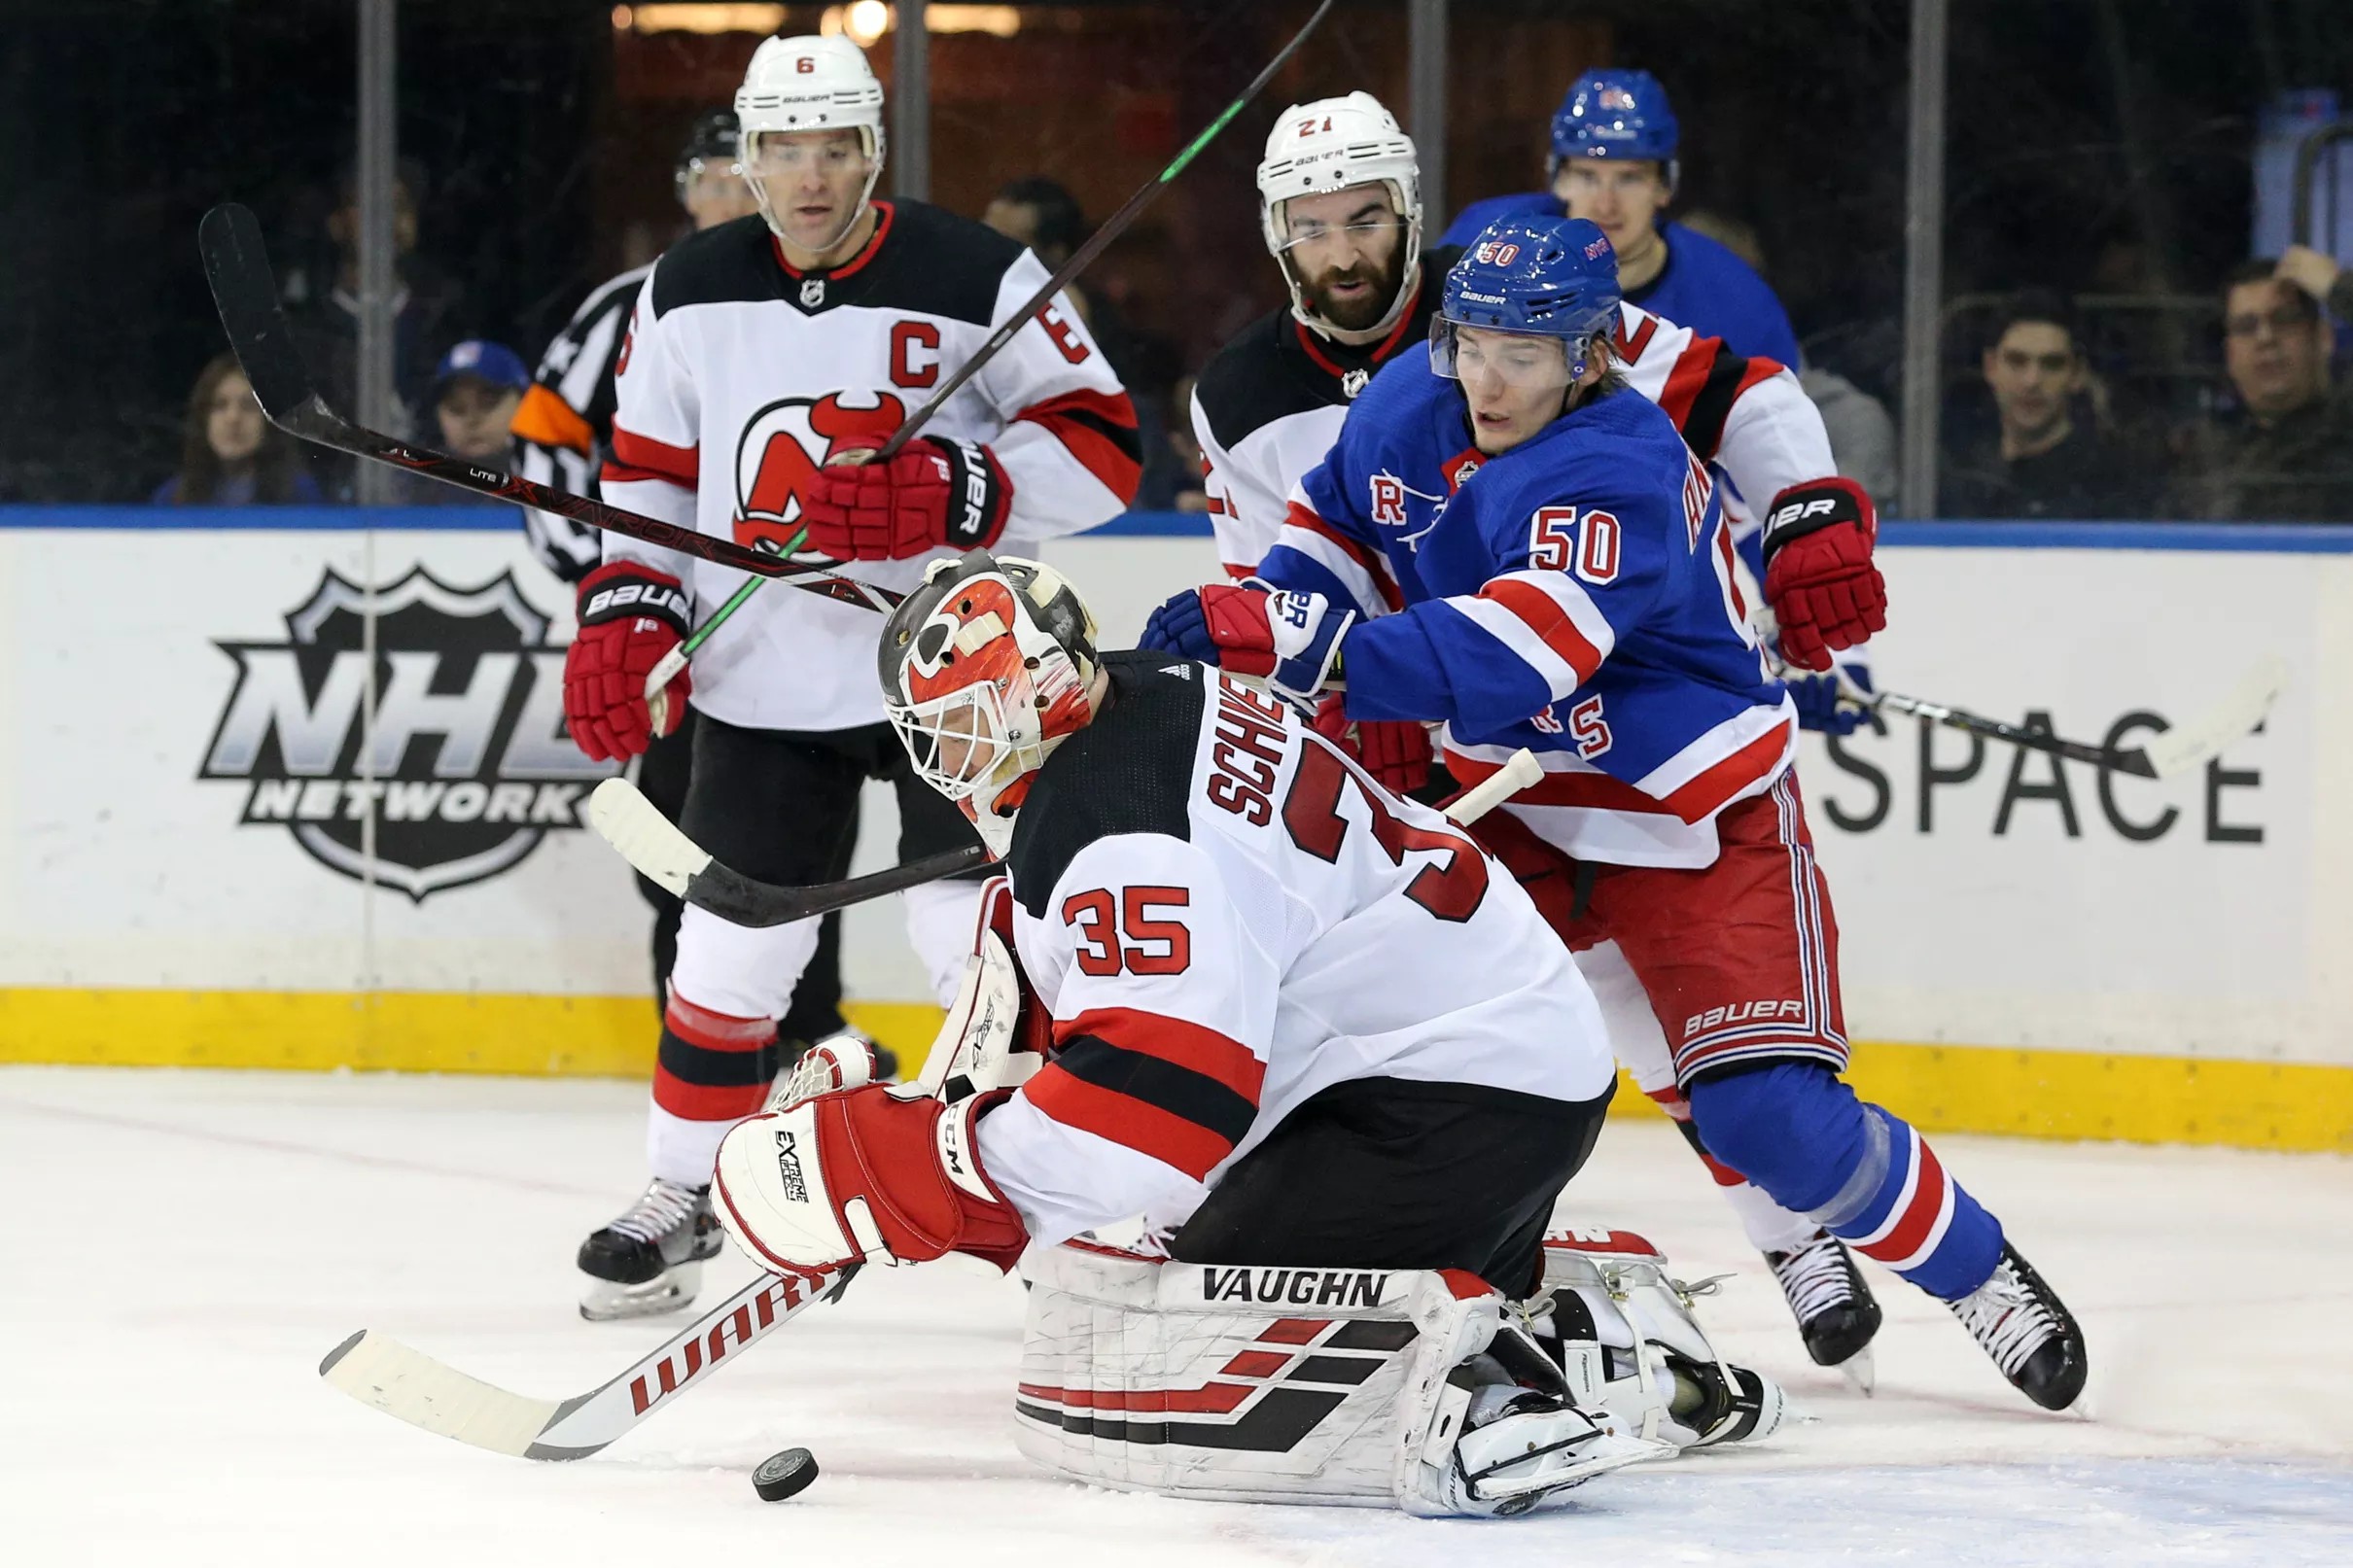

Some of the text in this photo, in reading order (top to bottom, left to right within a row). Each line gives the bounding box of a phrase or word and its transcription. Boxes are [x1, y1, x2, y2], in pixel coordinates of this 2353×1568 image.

[796, 57, 815, 74] 6
[1298, 117, 1331, 137] 21
[1476, 241, 1520, 267] 50
[1459, 291, 1507, 305] BAUER
[889, 320, 940, 388] C
[469, 468, 498, 483] LITE
[959, 442, 987, 535] UER
[1528, 505, 1622, 586] 50
[205, 649, 620, 776] NHL
[1821, 708, 2265, 845] SPACE
[250, 781, 581, 824] NETWORK
[1061, 885, 1191, 977] 35
[1684, 999, 1803, 1038] BAUER
[944, 1103, 965, 1175] CCM
[1204, 1268, 1388, 1307] VAUGHN
